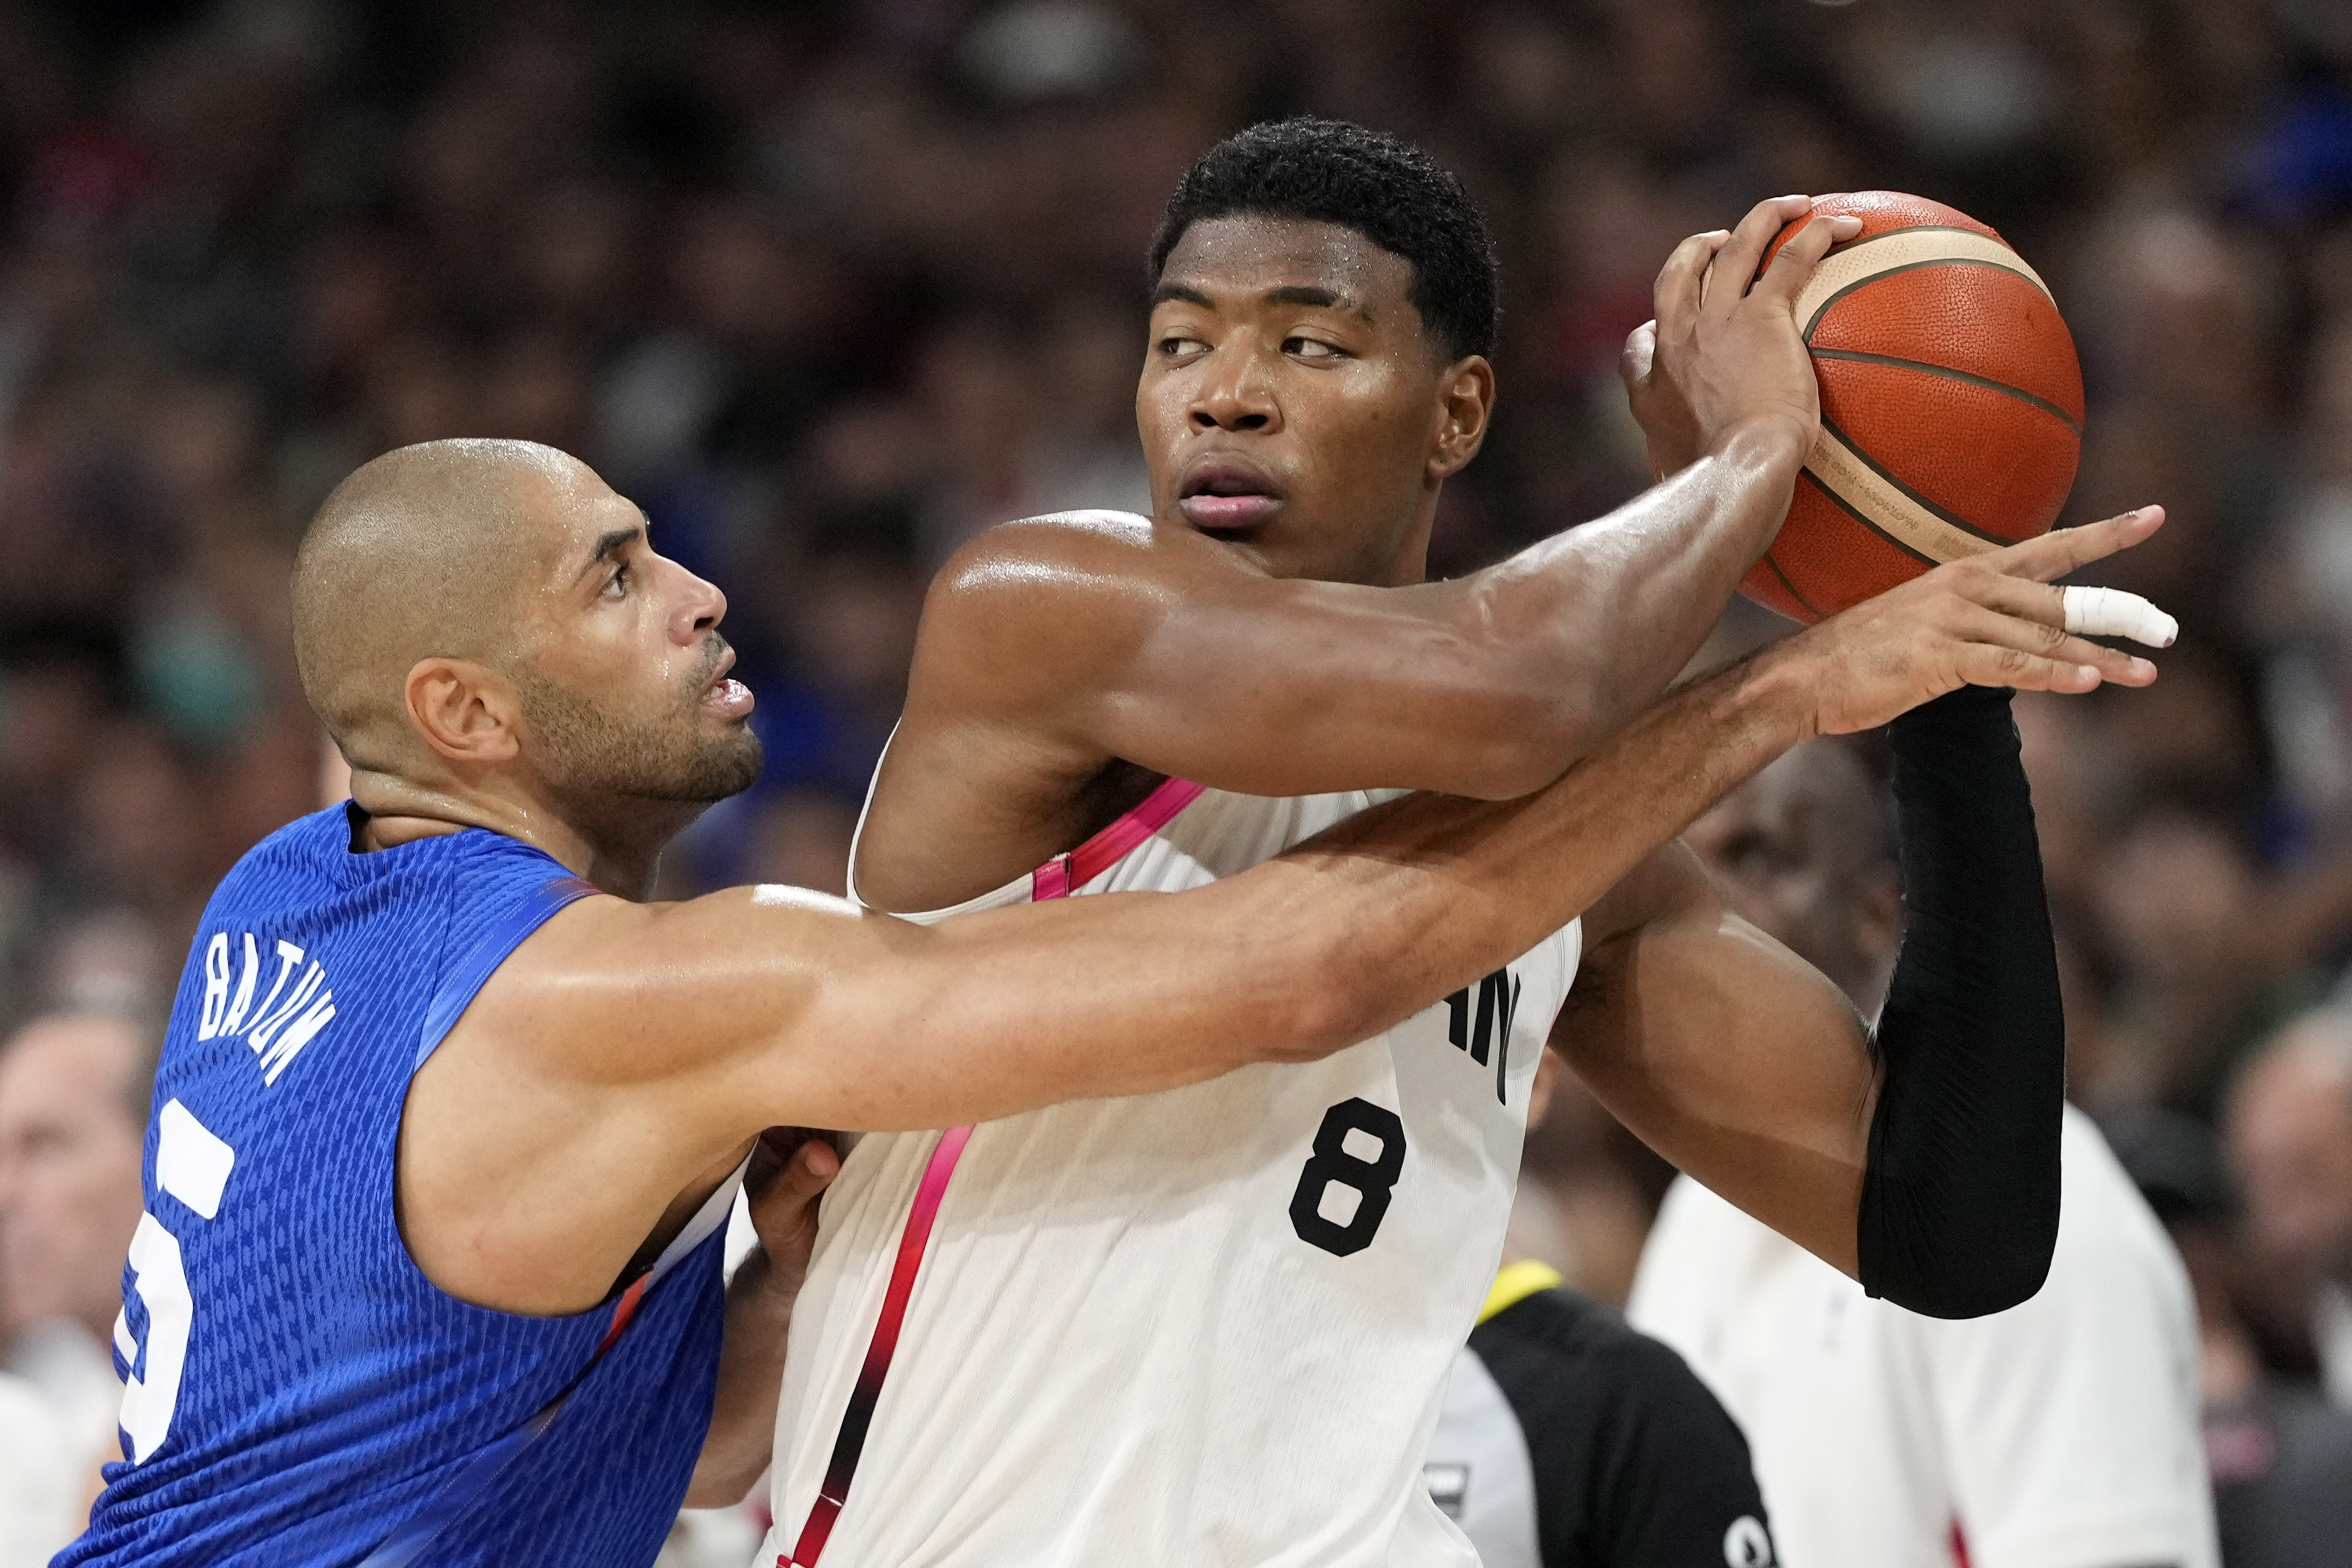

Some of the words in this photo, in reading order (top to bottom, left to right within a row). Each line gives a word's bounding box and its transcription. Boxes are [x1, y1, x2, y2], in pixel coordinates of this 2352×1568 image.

[198, 932, 336, 1088] BATUM
[1289, 1097, 1406, 1257] 8
[112, 1098, 235, 1467] 5
